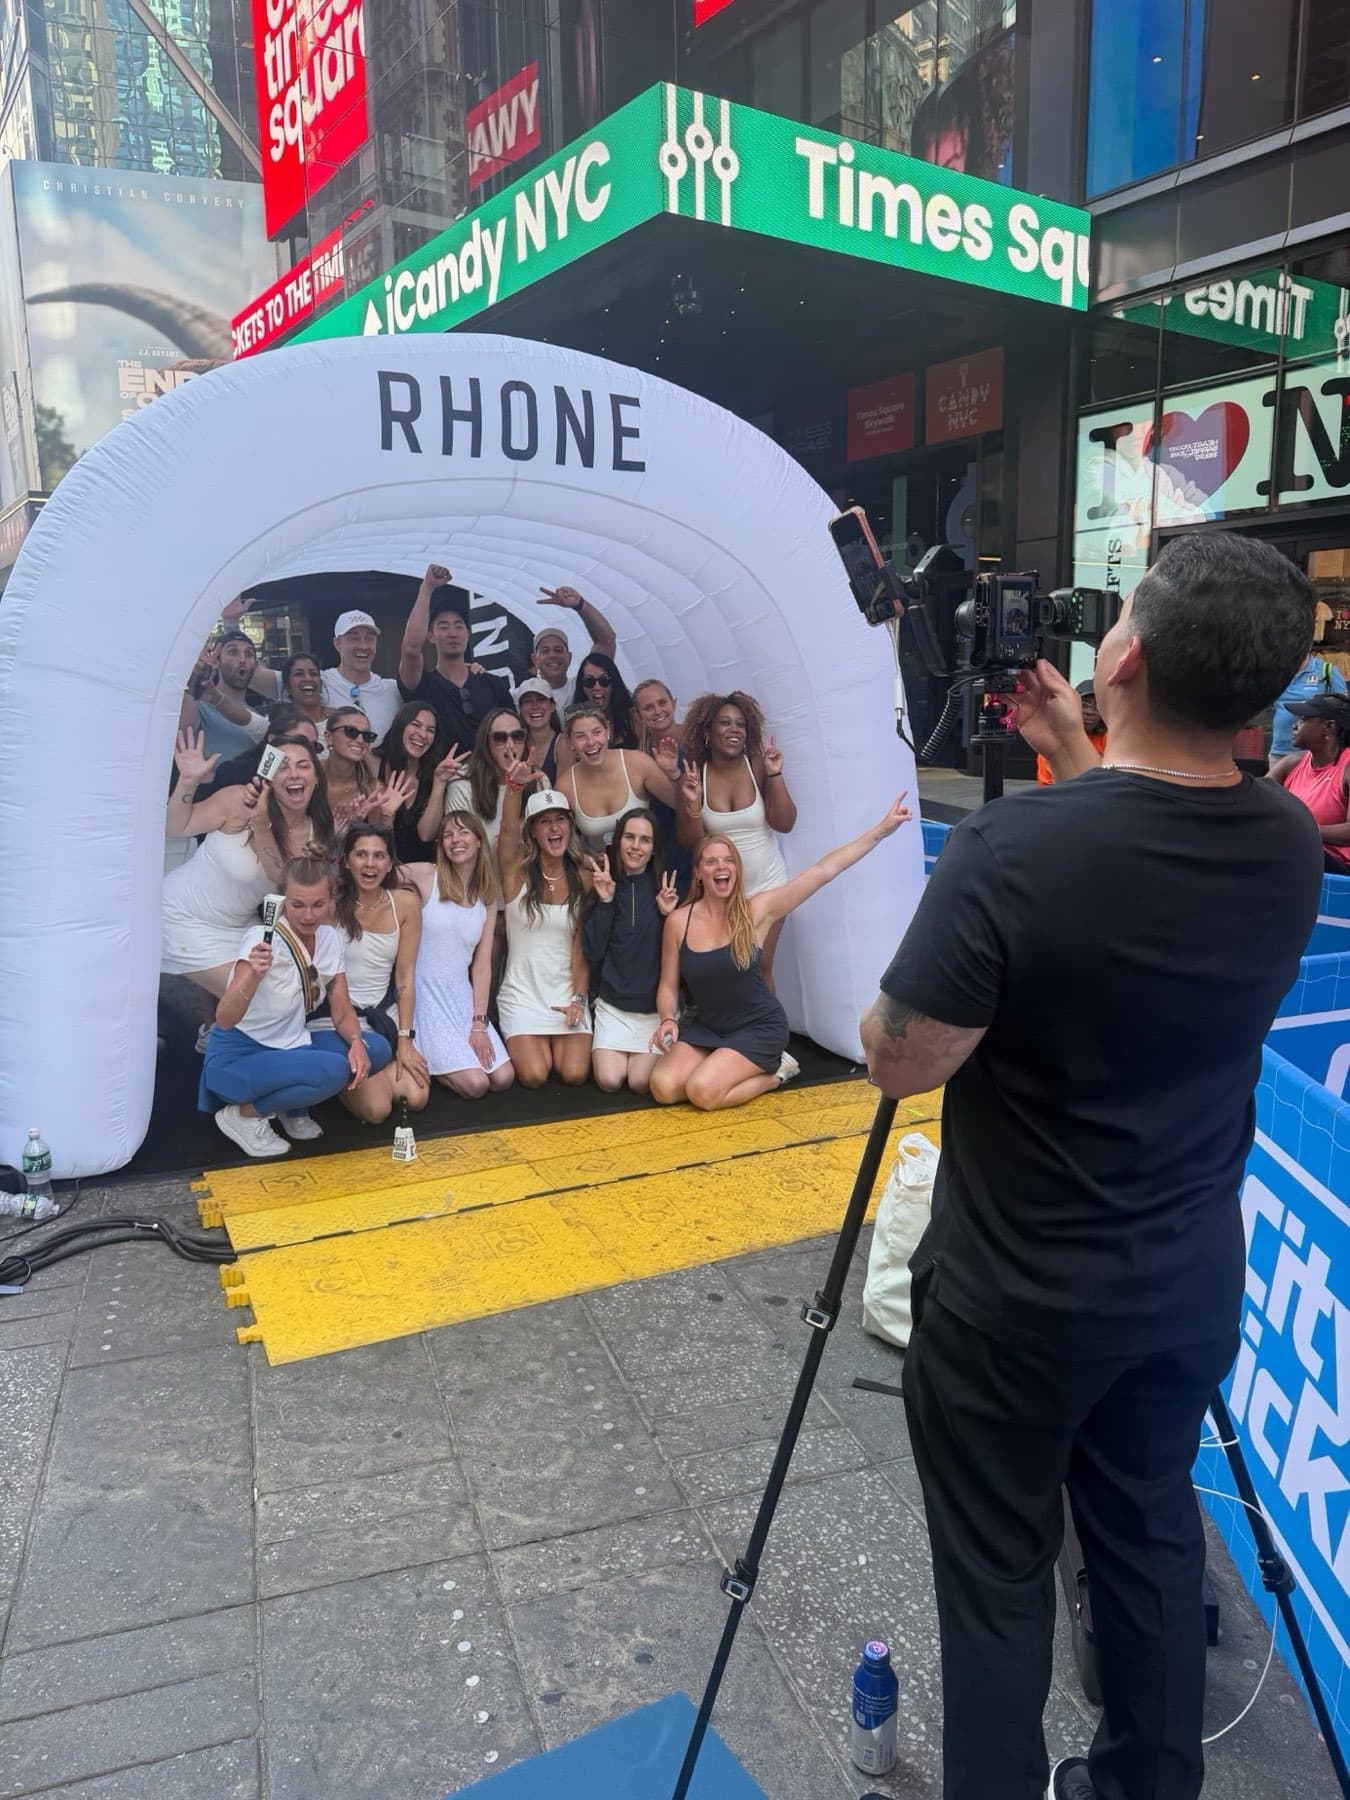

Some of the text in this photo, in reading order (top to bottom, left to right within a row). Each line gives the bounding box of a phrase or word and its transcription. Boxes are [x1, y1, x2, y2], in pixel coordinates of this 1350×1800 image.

[43, 179, 246, 209] CHRISTIAN CONVERY
[795, 136, 994, 262] Times
[384, 141, 611, 335] iCandy NYC
[265, 294, 284, 332] TO
[284, 269, 312, 318] THE
[117, 359, 142, 369] THE
[377, 370, 647, 472] RHONE
[265, 903, 277, 927] RHONE
